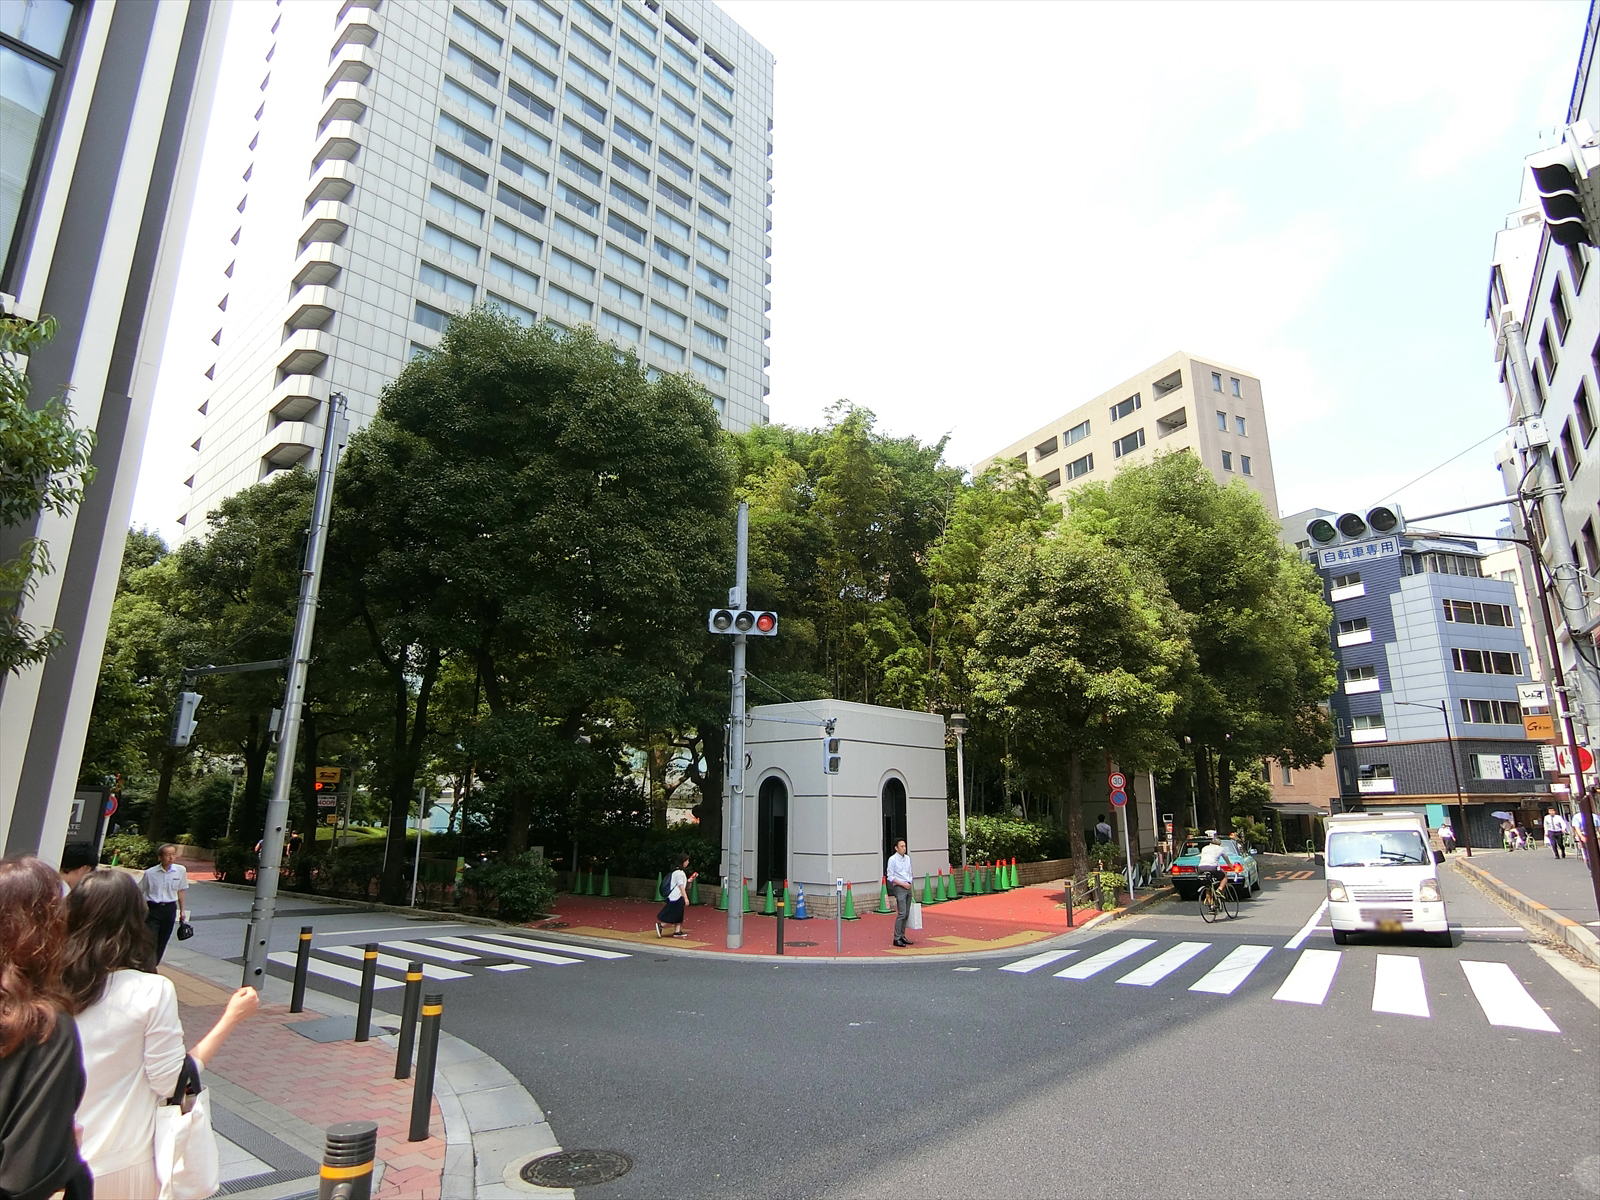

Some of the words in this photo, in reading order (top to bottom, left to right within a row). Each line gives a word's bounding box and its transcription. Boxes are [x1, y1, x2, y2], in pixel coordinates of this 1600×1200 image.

[1323, 541, 1394, 563] 自転車専用
[1112, 777, 1123, 785] 30
[315, 782, 323, 791] P
[1263, 870, 1315, 880] 30
